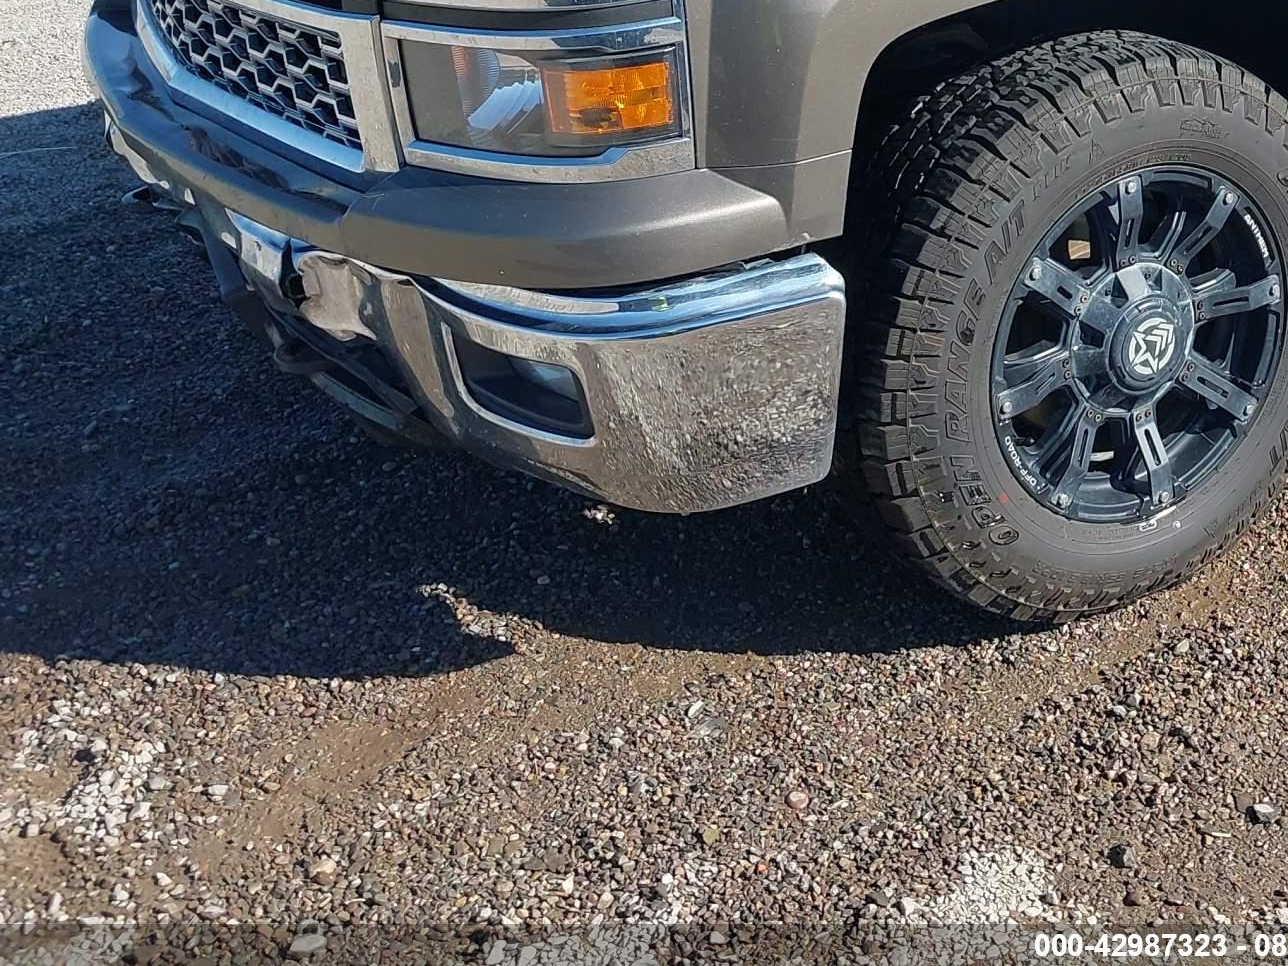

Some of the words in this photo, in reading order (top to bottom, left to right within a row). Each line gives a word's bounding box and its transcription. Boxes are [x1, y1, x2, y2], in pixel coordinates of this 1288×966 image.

[1243, 214, 1269, 258] ANTHEM
[944, 278, 986, 443] RANGE
[1004, 435, 1038, 487] OFF-ROAD
[950, 454, 1019, 545] OPEN
